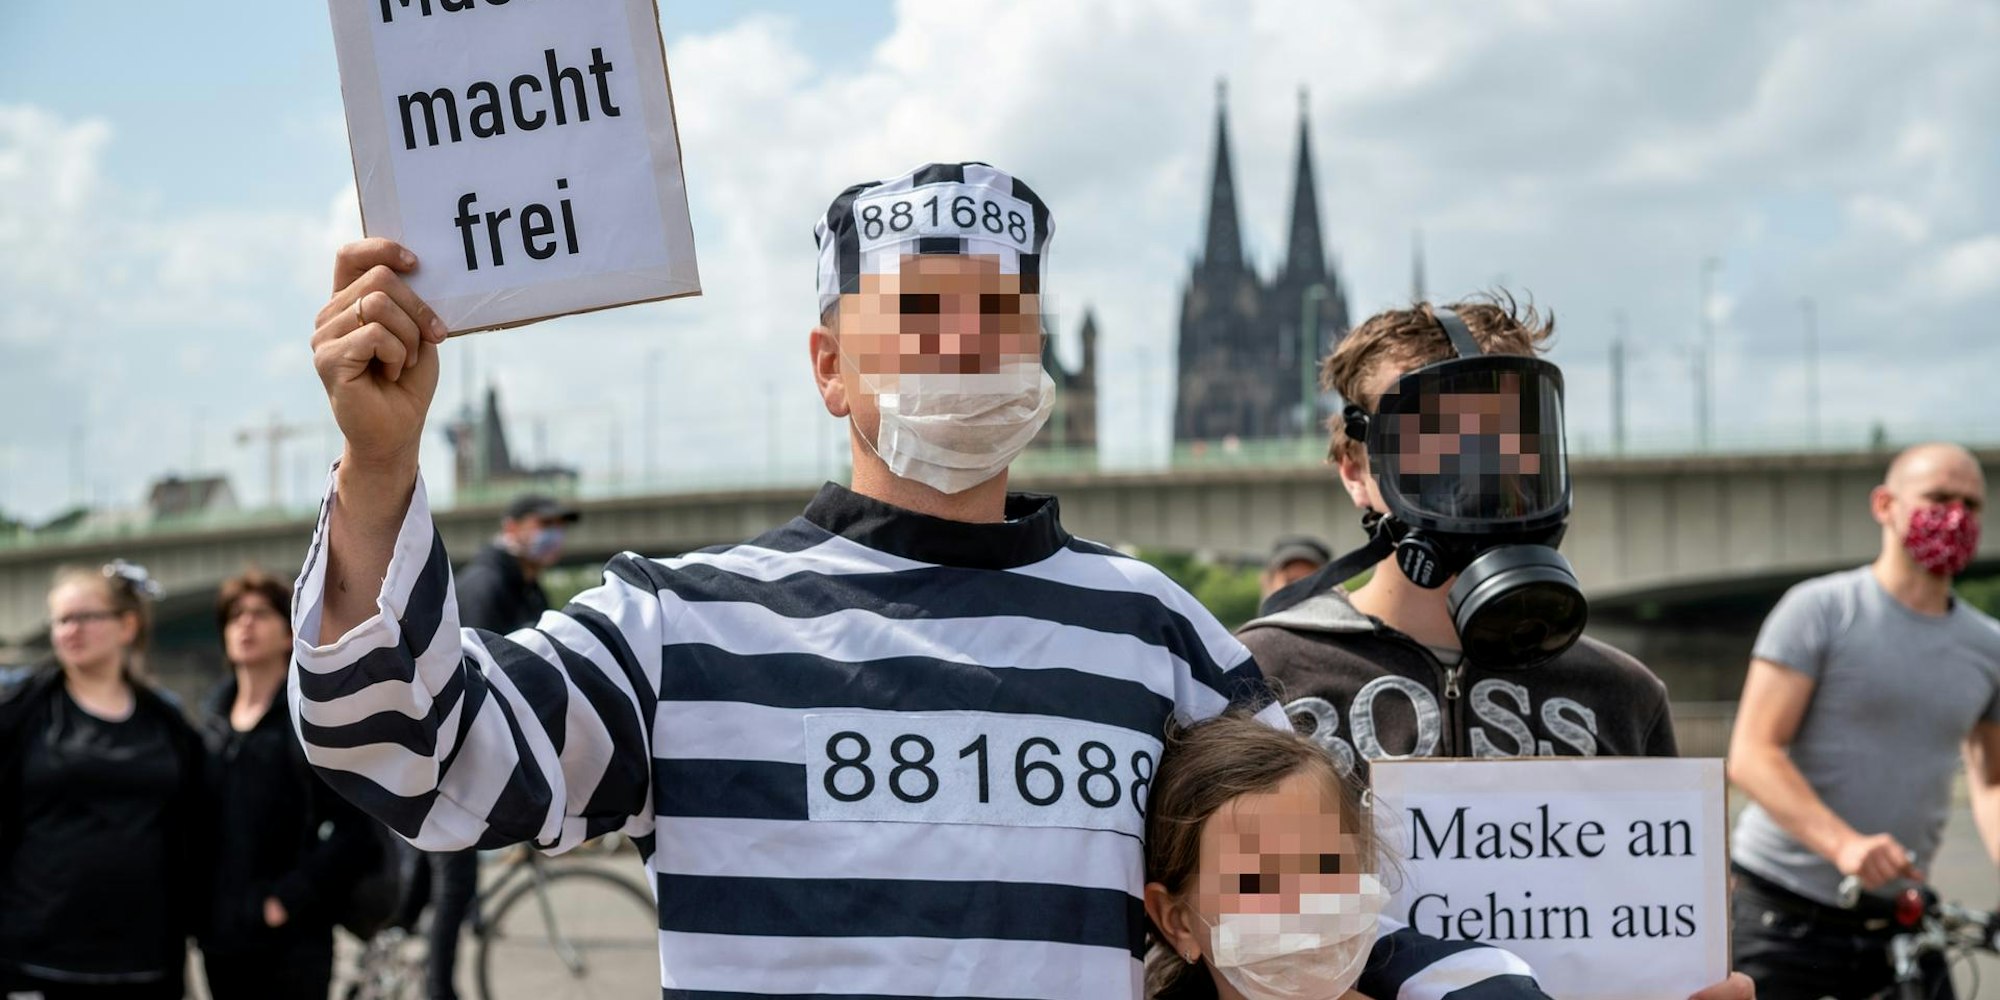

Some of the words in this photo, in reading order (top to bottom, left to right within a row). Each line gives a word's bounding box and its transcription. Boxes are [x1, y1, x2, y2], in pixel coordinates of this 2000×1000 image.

[397, 47, 621, 150] macht
[454, 178, 580, 272] frei
[861, 195, 1027, 244] 881688
[1406, 803, 1606, 860] Maske
[1627, 817, 1697, 858] an
[1407, 891, 1593, 941] Gehirn
[1611, 902, 1697, 938] aus
